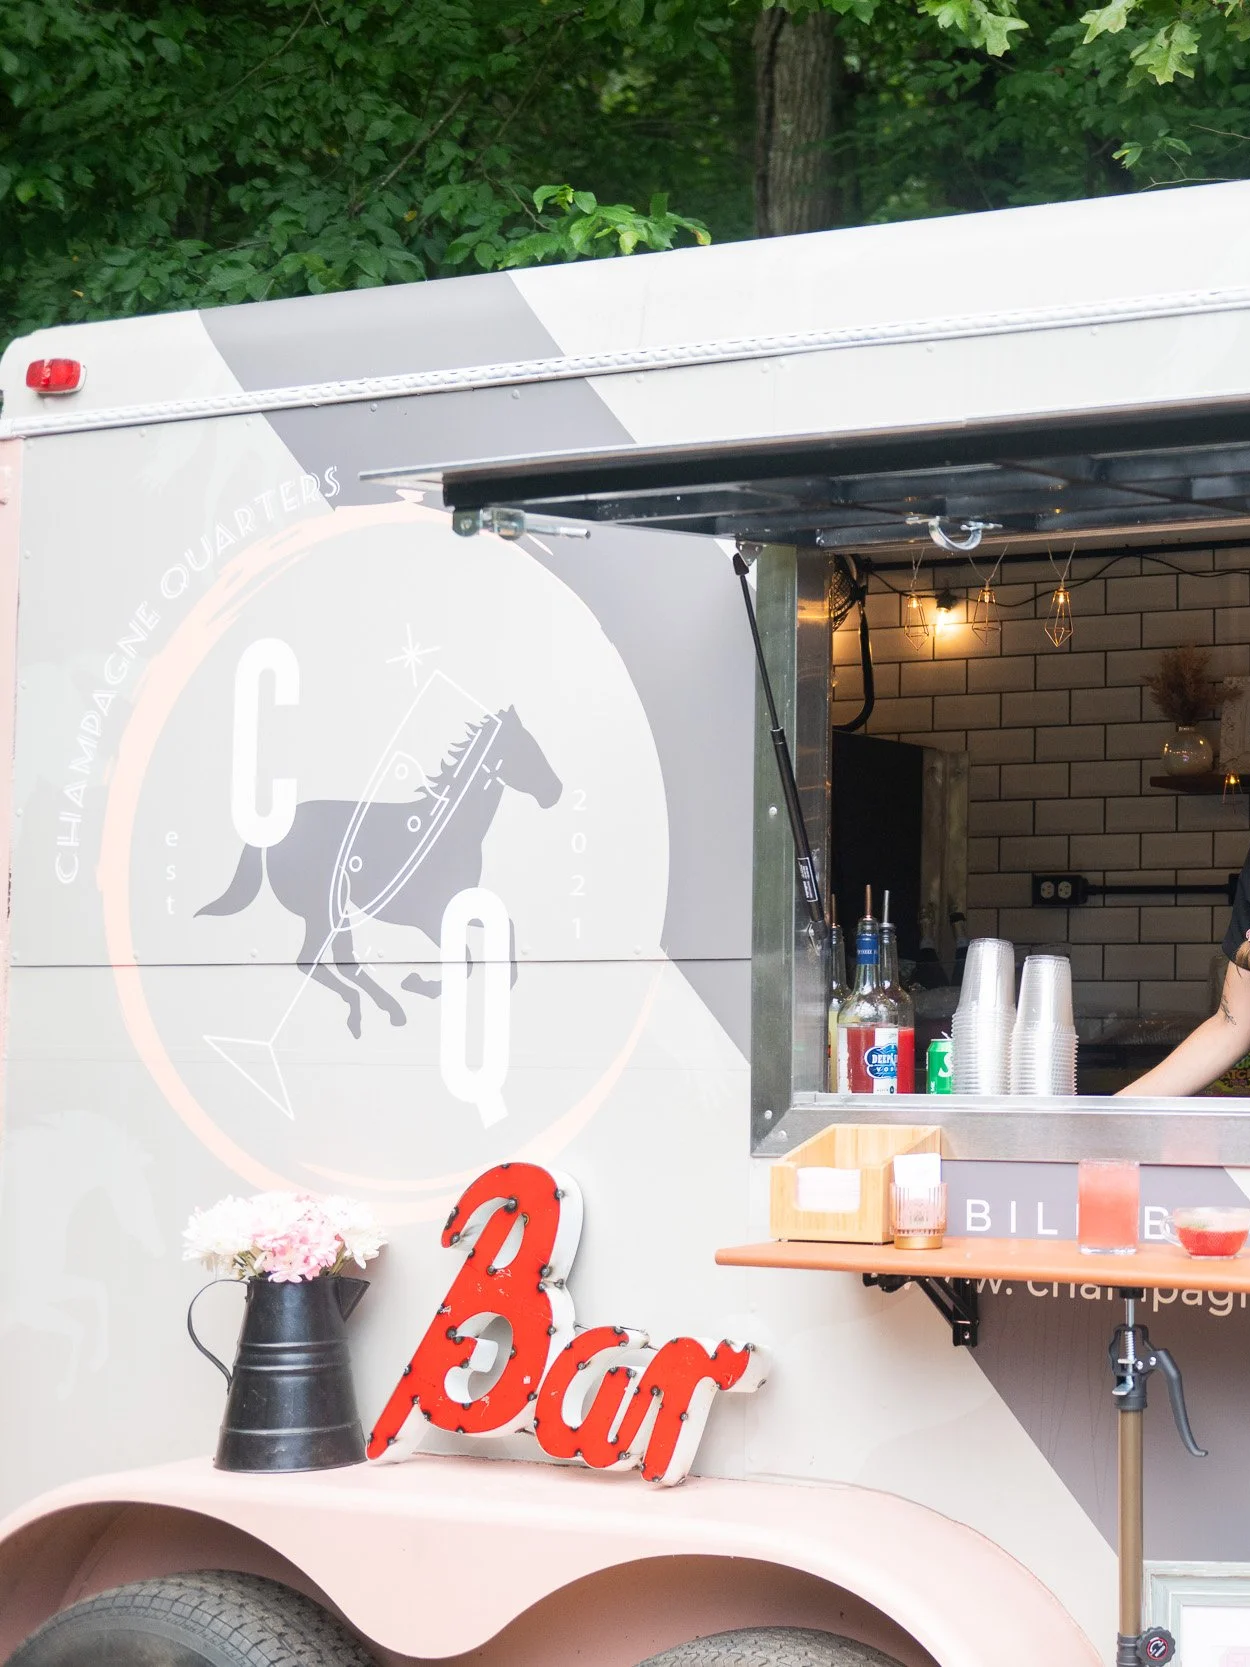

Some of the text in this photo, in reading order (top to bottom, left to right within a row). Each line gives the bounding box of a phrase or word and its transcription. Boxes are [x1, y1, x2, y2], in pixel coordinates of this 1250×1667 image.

[55, 465, 341, 884] CHAMPAGNE QUARTERS
[231, 637, 300, 848] C
[440, 886, 511, 1129] Q
[366, 1161, 768, 1488] Bar
[966, 1199, 1079, 1237] BIL
